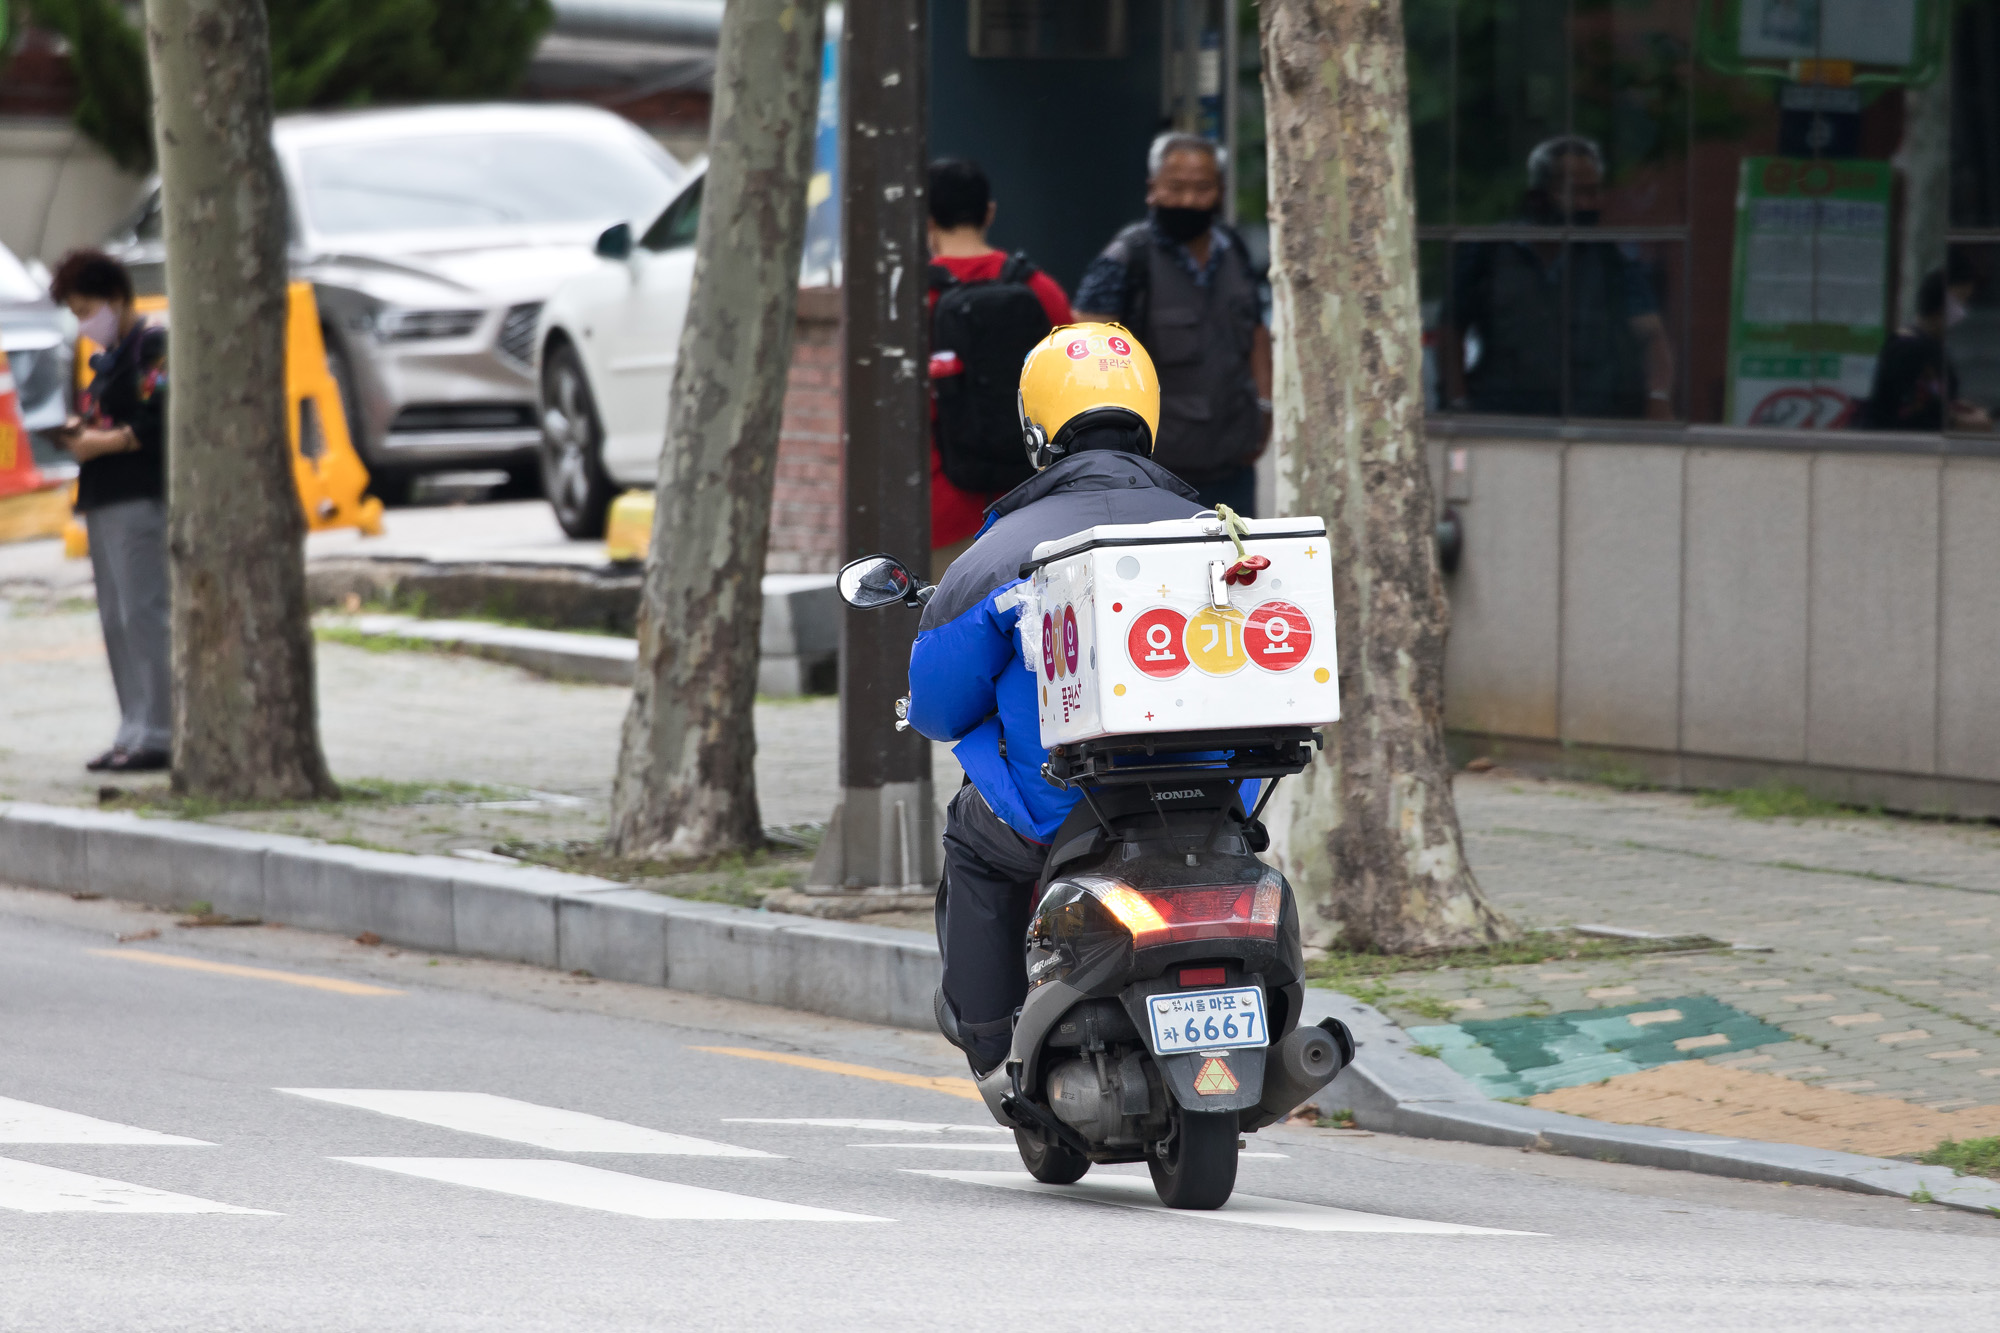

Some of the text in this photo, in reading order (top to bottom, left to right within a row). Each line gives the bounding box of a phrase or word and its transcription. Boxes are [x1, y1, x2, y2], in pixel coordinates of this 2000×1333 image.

[1045, 620, 1076, 665] 요기요
[1144, 616, 1295, 662] 요기요
[1150, 788, 1205, 801] HONDA
[1184, 999, 1206, 1013] 서울
[1209, 995, 1237, 1012] 마포
[1163, 1011, 1256, 1044] 차 6667
